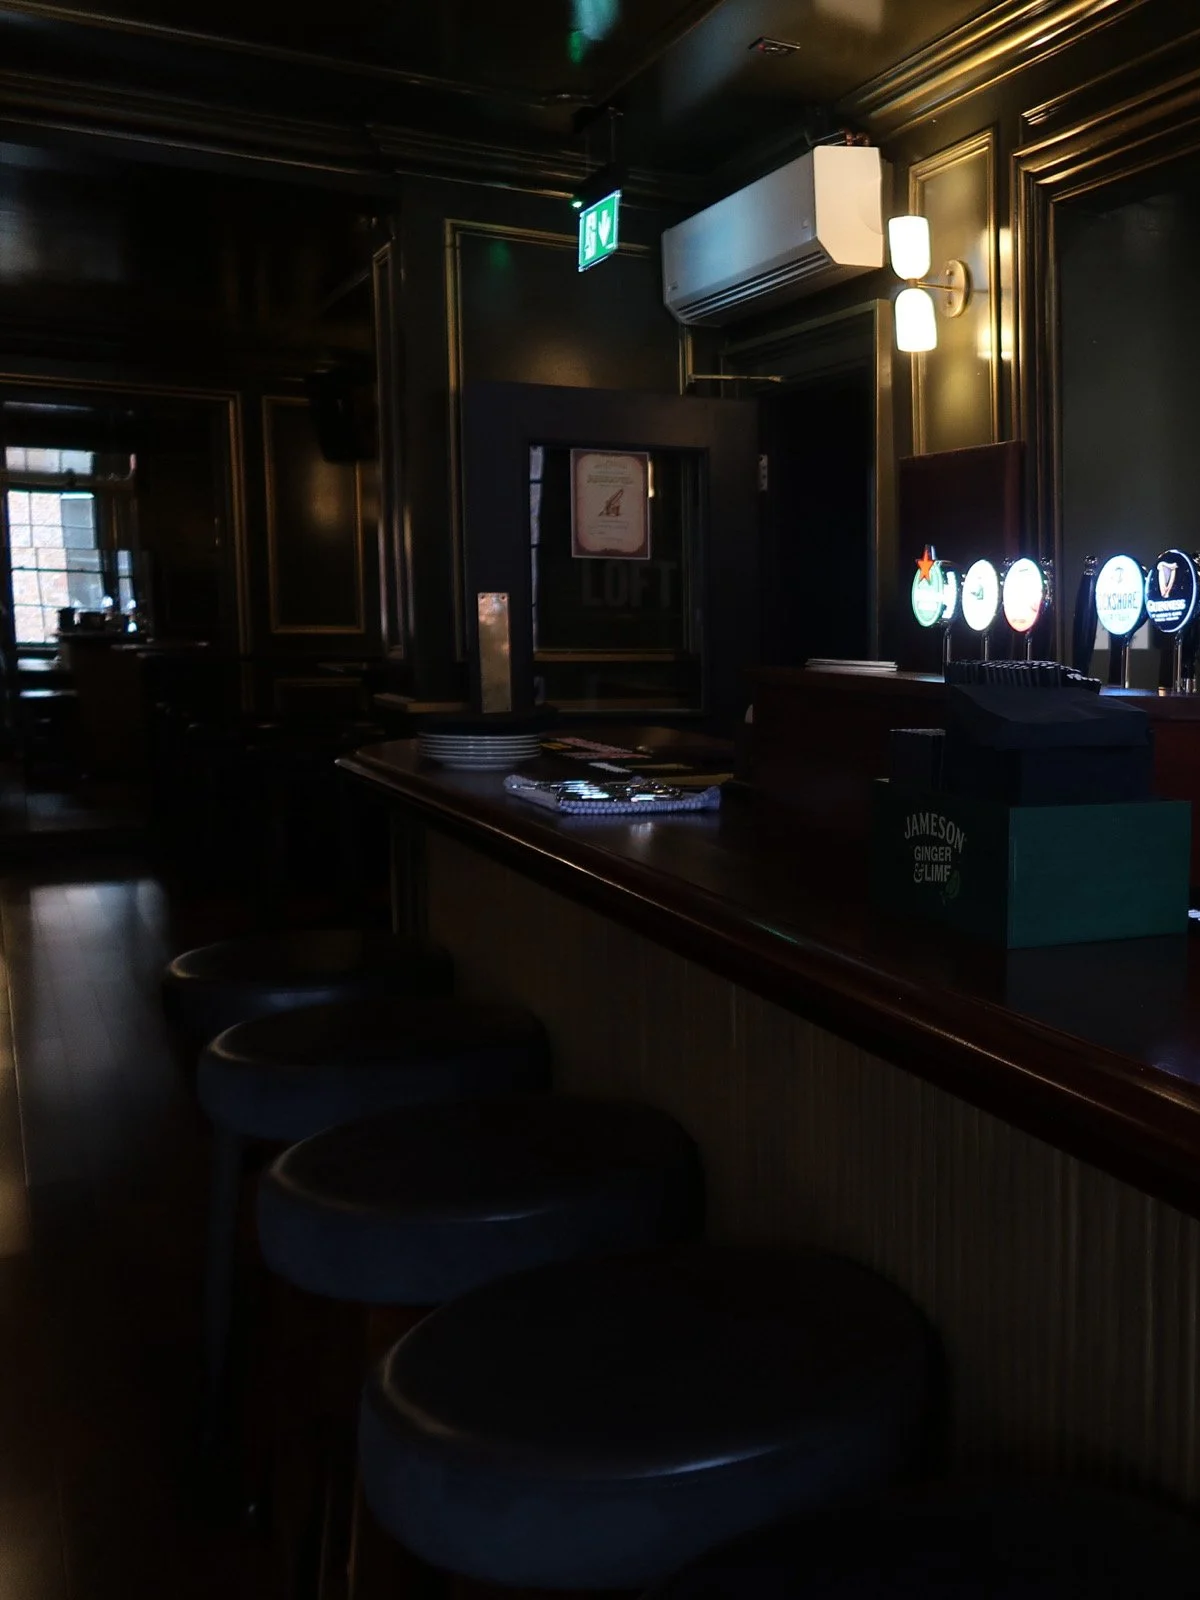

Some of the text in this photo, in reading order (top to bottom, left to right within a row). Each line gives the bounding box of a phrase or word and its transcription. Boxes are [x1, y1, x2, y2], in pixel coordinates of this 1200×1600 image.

[581, 559, 678, 608] LOFT
[1146, 598, 1186, 613] GUINNESS
[904, 812, 965, 855] JAMESON
[913, 845, 952, 862] GINGER
